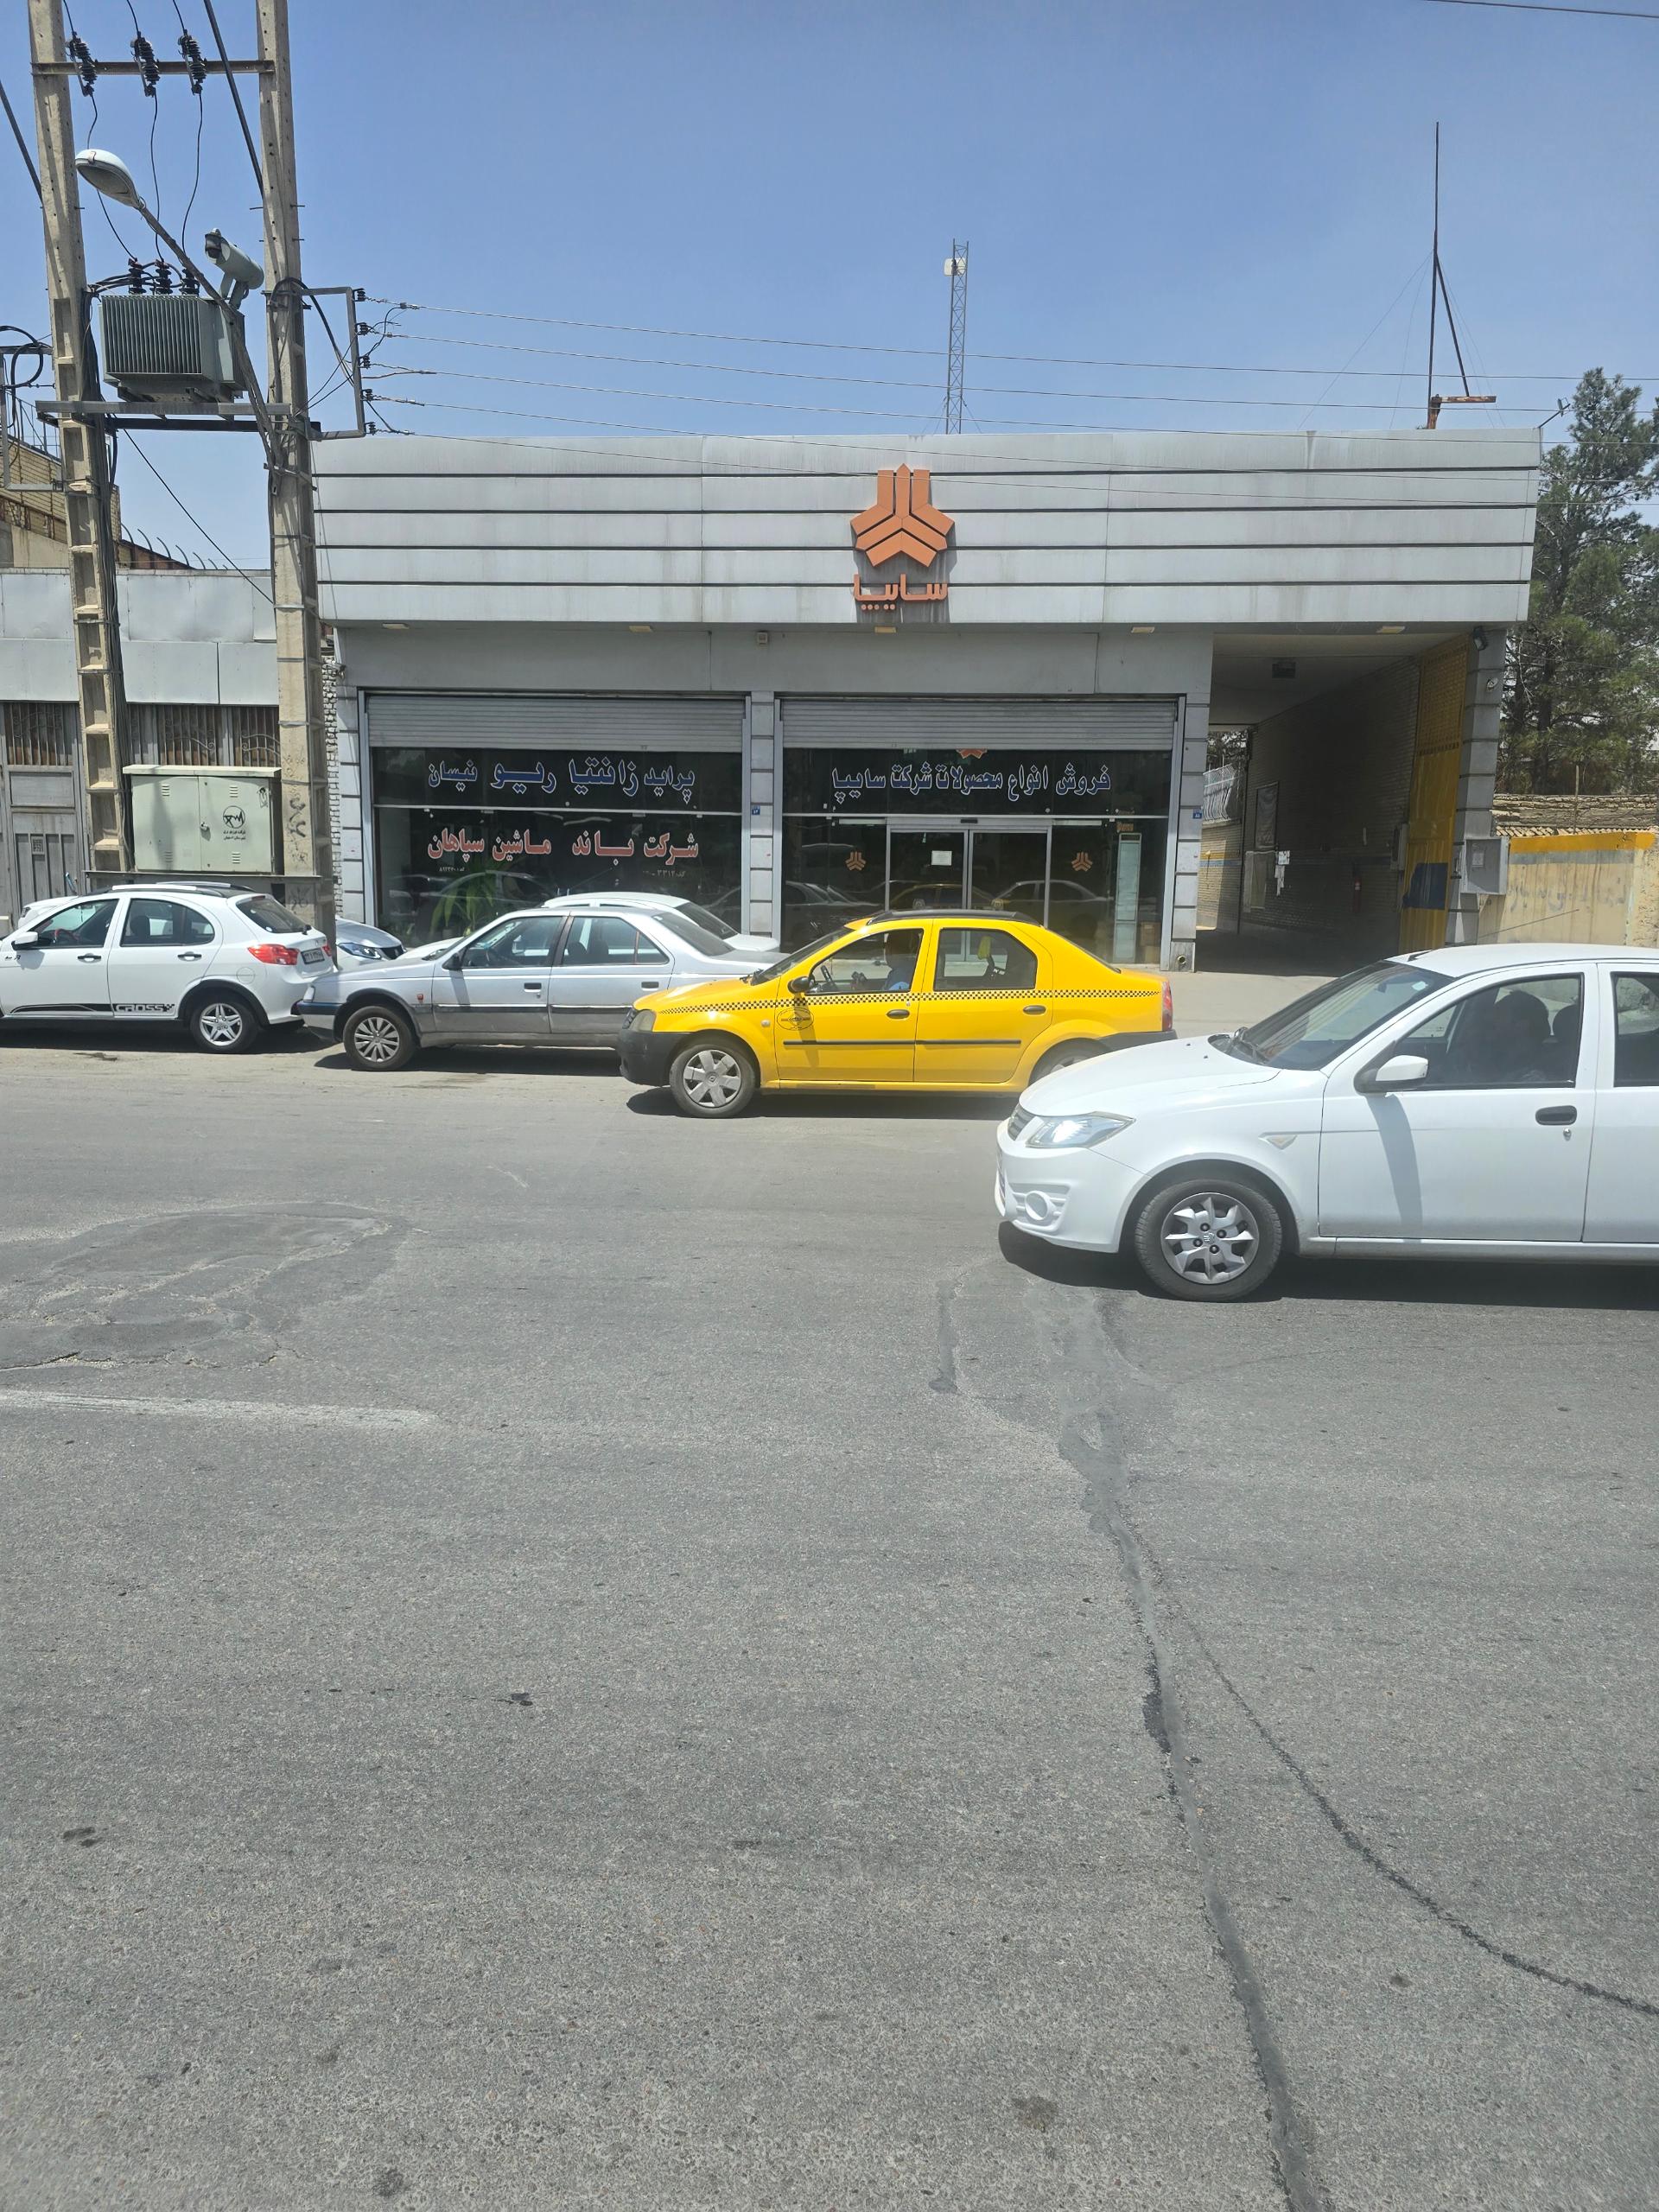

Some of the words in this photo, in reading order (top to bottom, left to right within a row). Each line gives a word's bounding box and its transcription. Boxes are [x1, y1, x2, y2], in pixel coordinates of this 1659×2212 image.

[853, 573, 948, 610] سایپا
[428, 760, 478, 791] نیسان
[491, 761, 557, 794] ریو
[569, 756, 639, 797] زانتیا
[644, 765, 696, 804] پراید
[832, 767, 886, 804] سایپا
[890, 761, 932, 796] شرکت
[935, 764, 1003, 796] محصولات
[1007, 764, 1048, 802] انواع
[1055, 762, 1111, 796] فروش
[427, 827, 485, 863] سپاهان
[492, 829, 552, 861] ماشین
[571, 830, 634, 866] باند
[643, 832, 699, 866] شرکت
